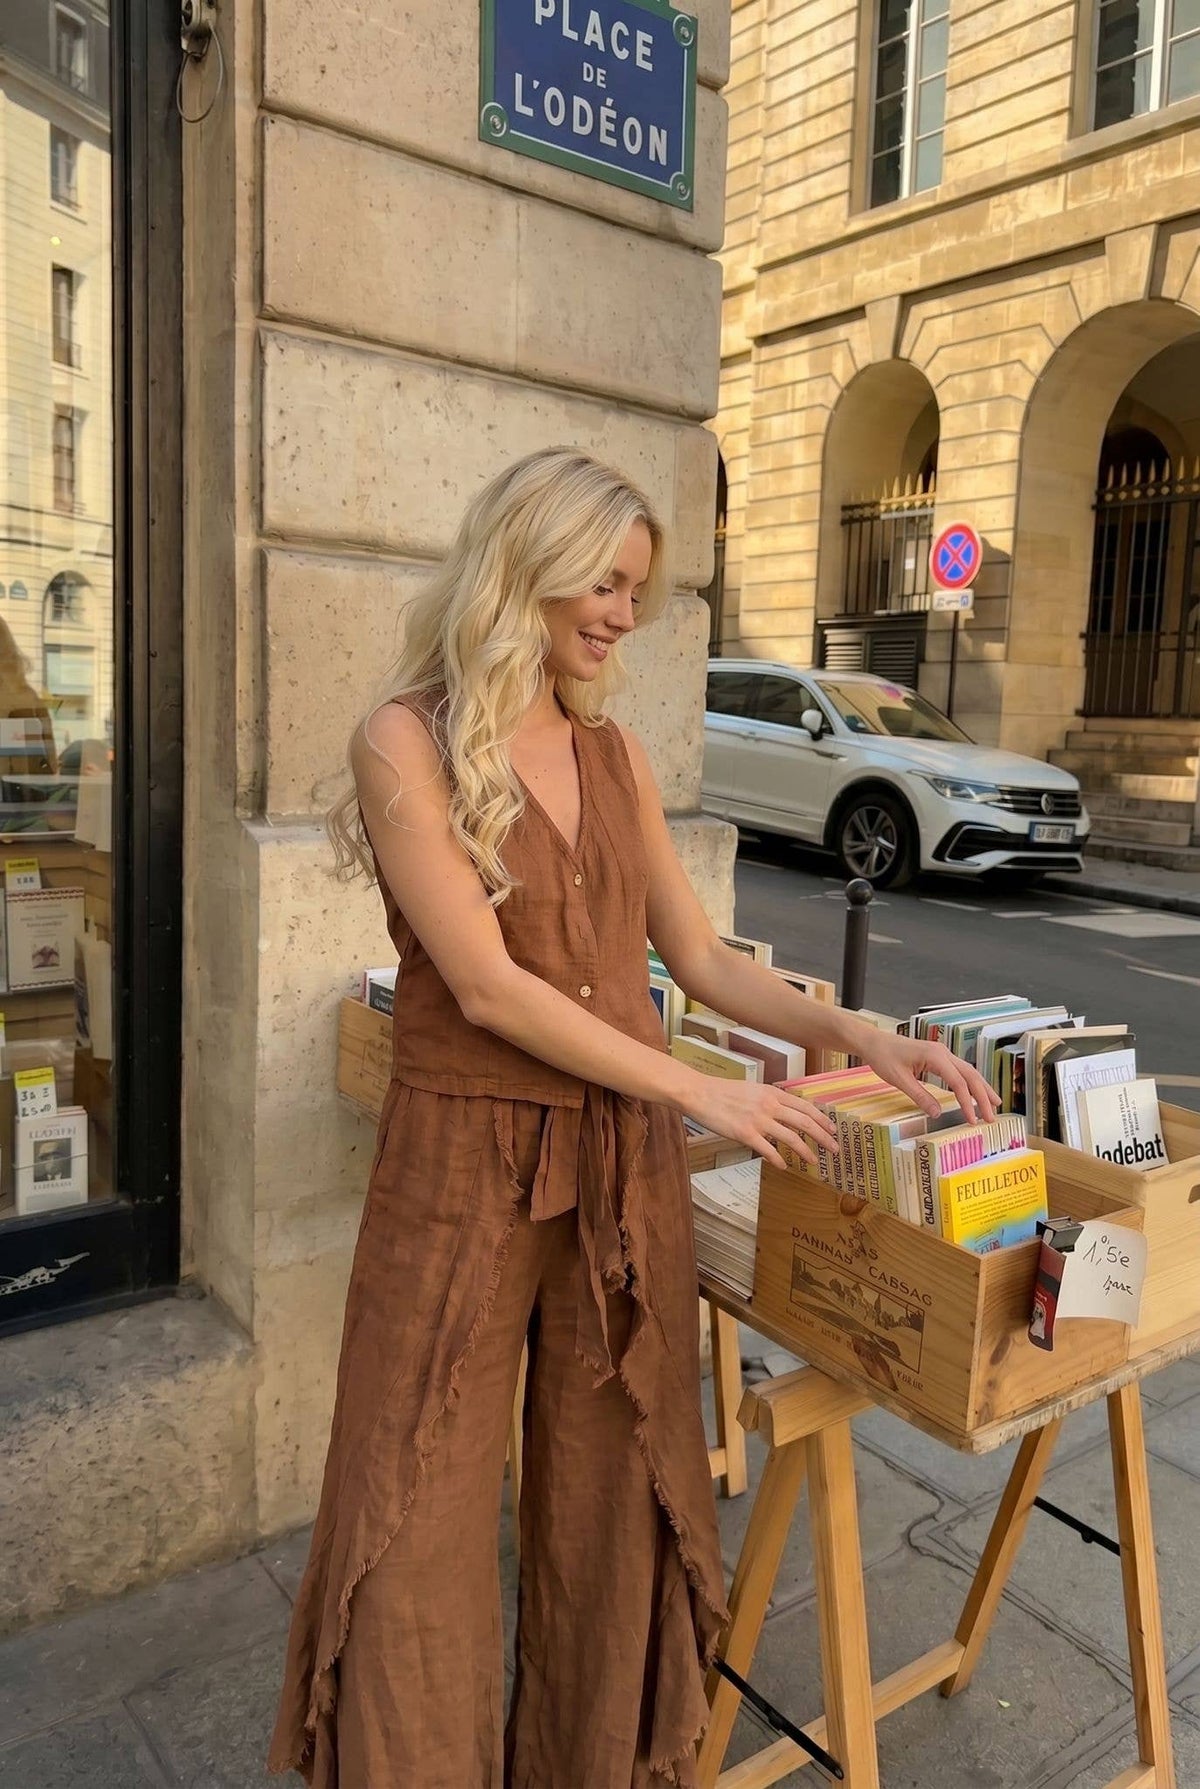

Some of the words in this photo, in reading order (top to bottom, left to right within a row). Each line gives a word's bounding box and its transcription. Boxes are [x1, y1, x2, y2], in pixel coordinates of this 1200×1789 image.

[534, 0, 653, 71] PLACE
[583, 62, 607, 88] DE
[515, 72, 667, 166] L'ODÉON
[956, 1164, 1040, 1202] FEUILLETON
